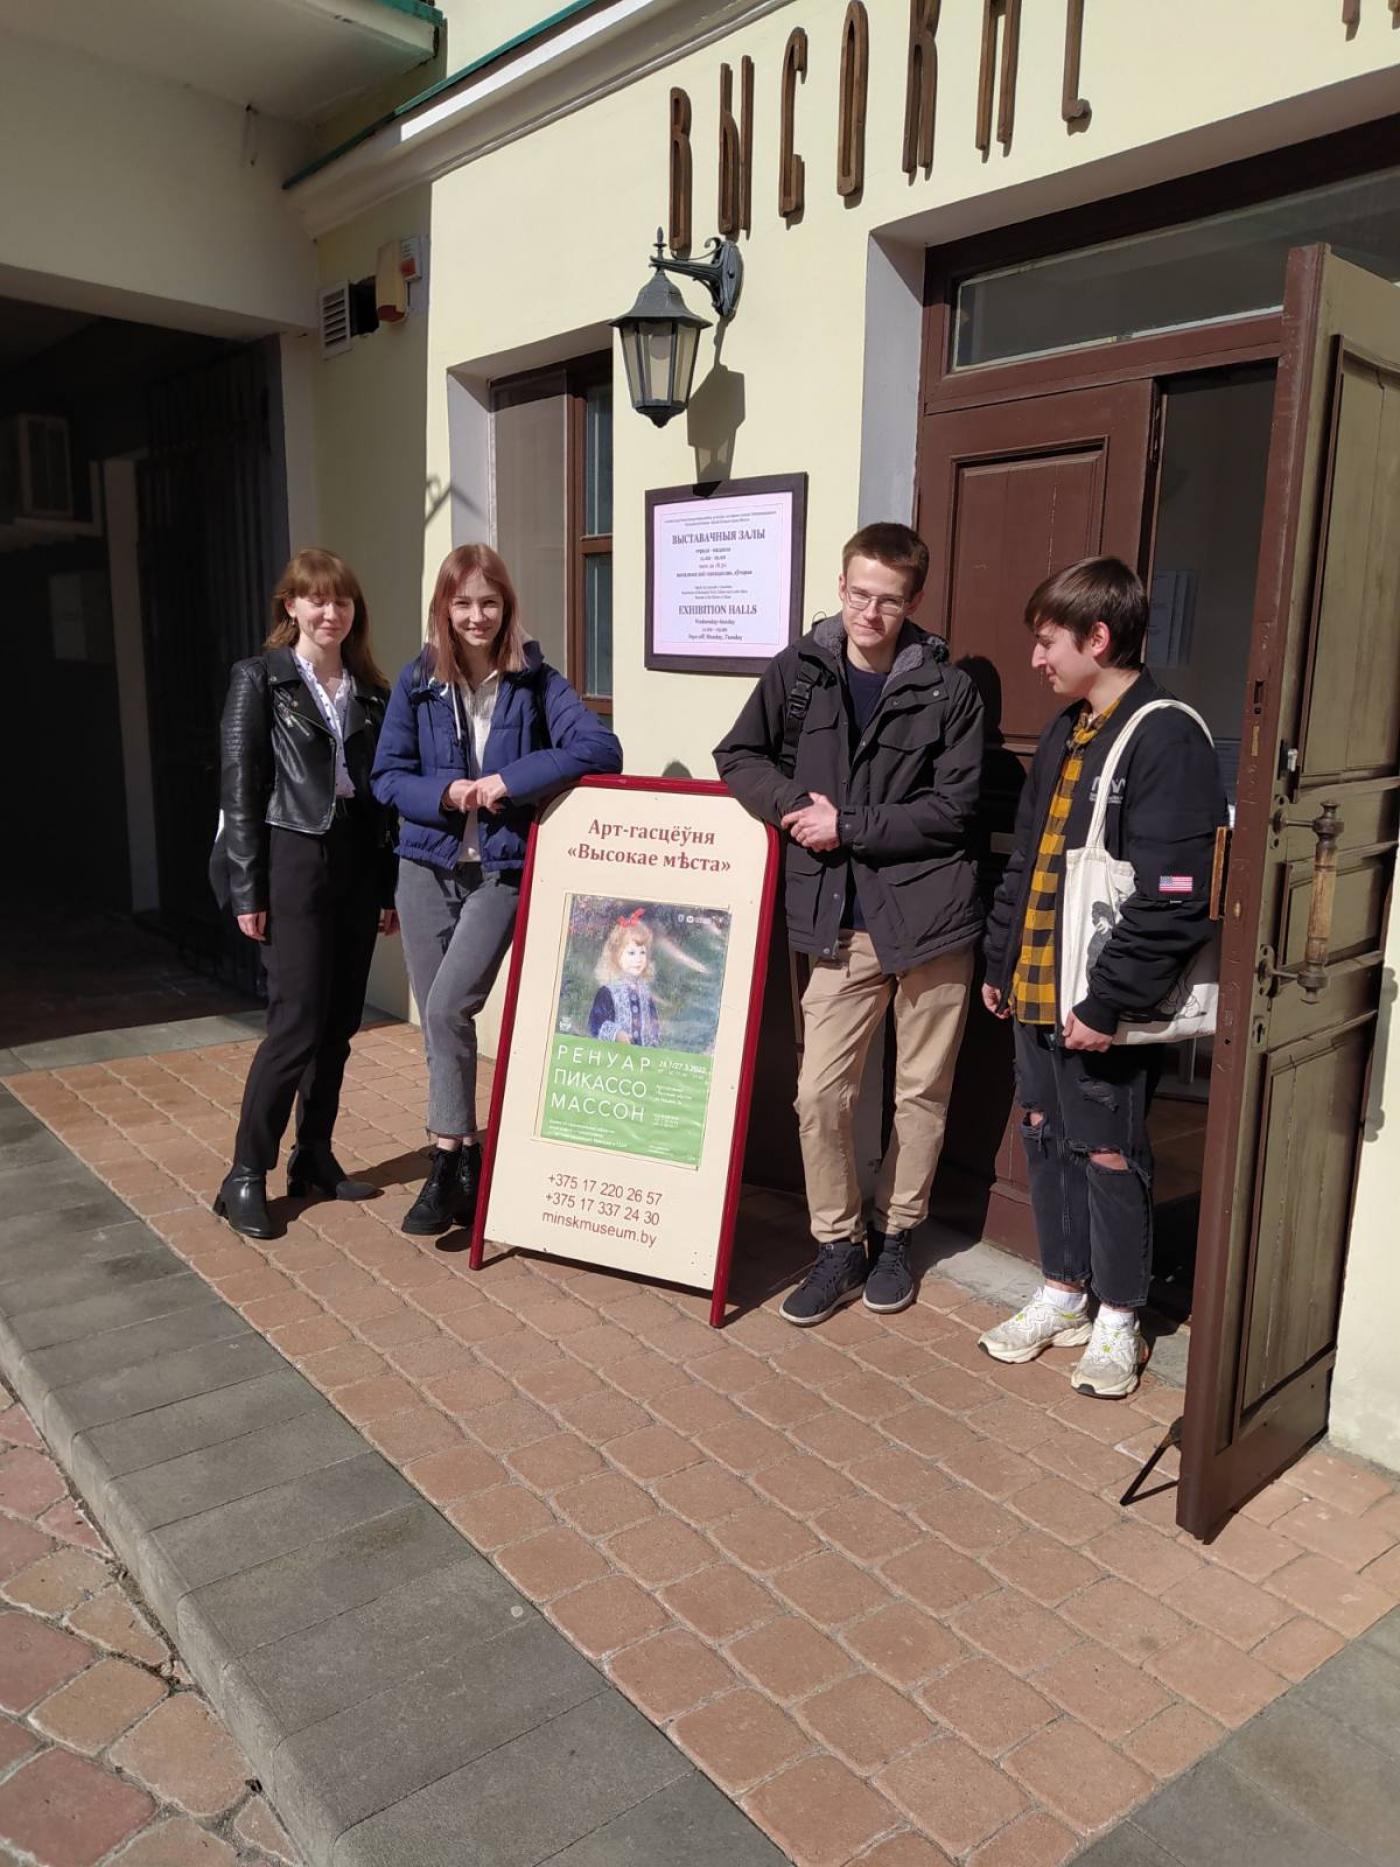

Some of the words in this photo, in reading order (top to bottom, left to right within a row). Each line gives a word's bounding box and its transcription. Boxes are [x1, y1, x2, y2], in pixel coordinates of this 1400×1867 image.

[672, 530, 737, 545] ВЫСТАВАЧНЫЯ
[738, 528, 766, 541] ЗАЛЫ
[678, 605, 727, 616] EXHIBITION
[728, 604, 758, 615] HALLS
[588, 818, 715, 847] Арт-гасцёўня
[567, 843, 659, 867] «Высокае
[557, 1044, 651, 1073] РЕНУАР
[554, 1068, 647, 1098] ПИКАССО
[551, 1092, 645, 1123] МАССОН
[548, 1173, 578, 1190] +375
[583, 1179, 597, 1193] 17
[600, 1182, 624, 1199] 220
[626, 1187, 643, 1203] 26
[646, 1191, 663, 1206] 57
[545, 1192, 576, 1208] +375
[580, 1198, 595, 1212] 17
[597, 1201, 621, 1217] 337
[624, 1206, 640, 1222] 24
[643, 1210, 660, 1226] 30
[542, 1211, 658, 1249] minskmuseum.by
